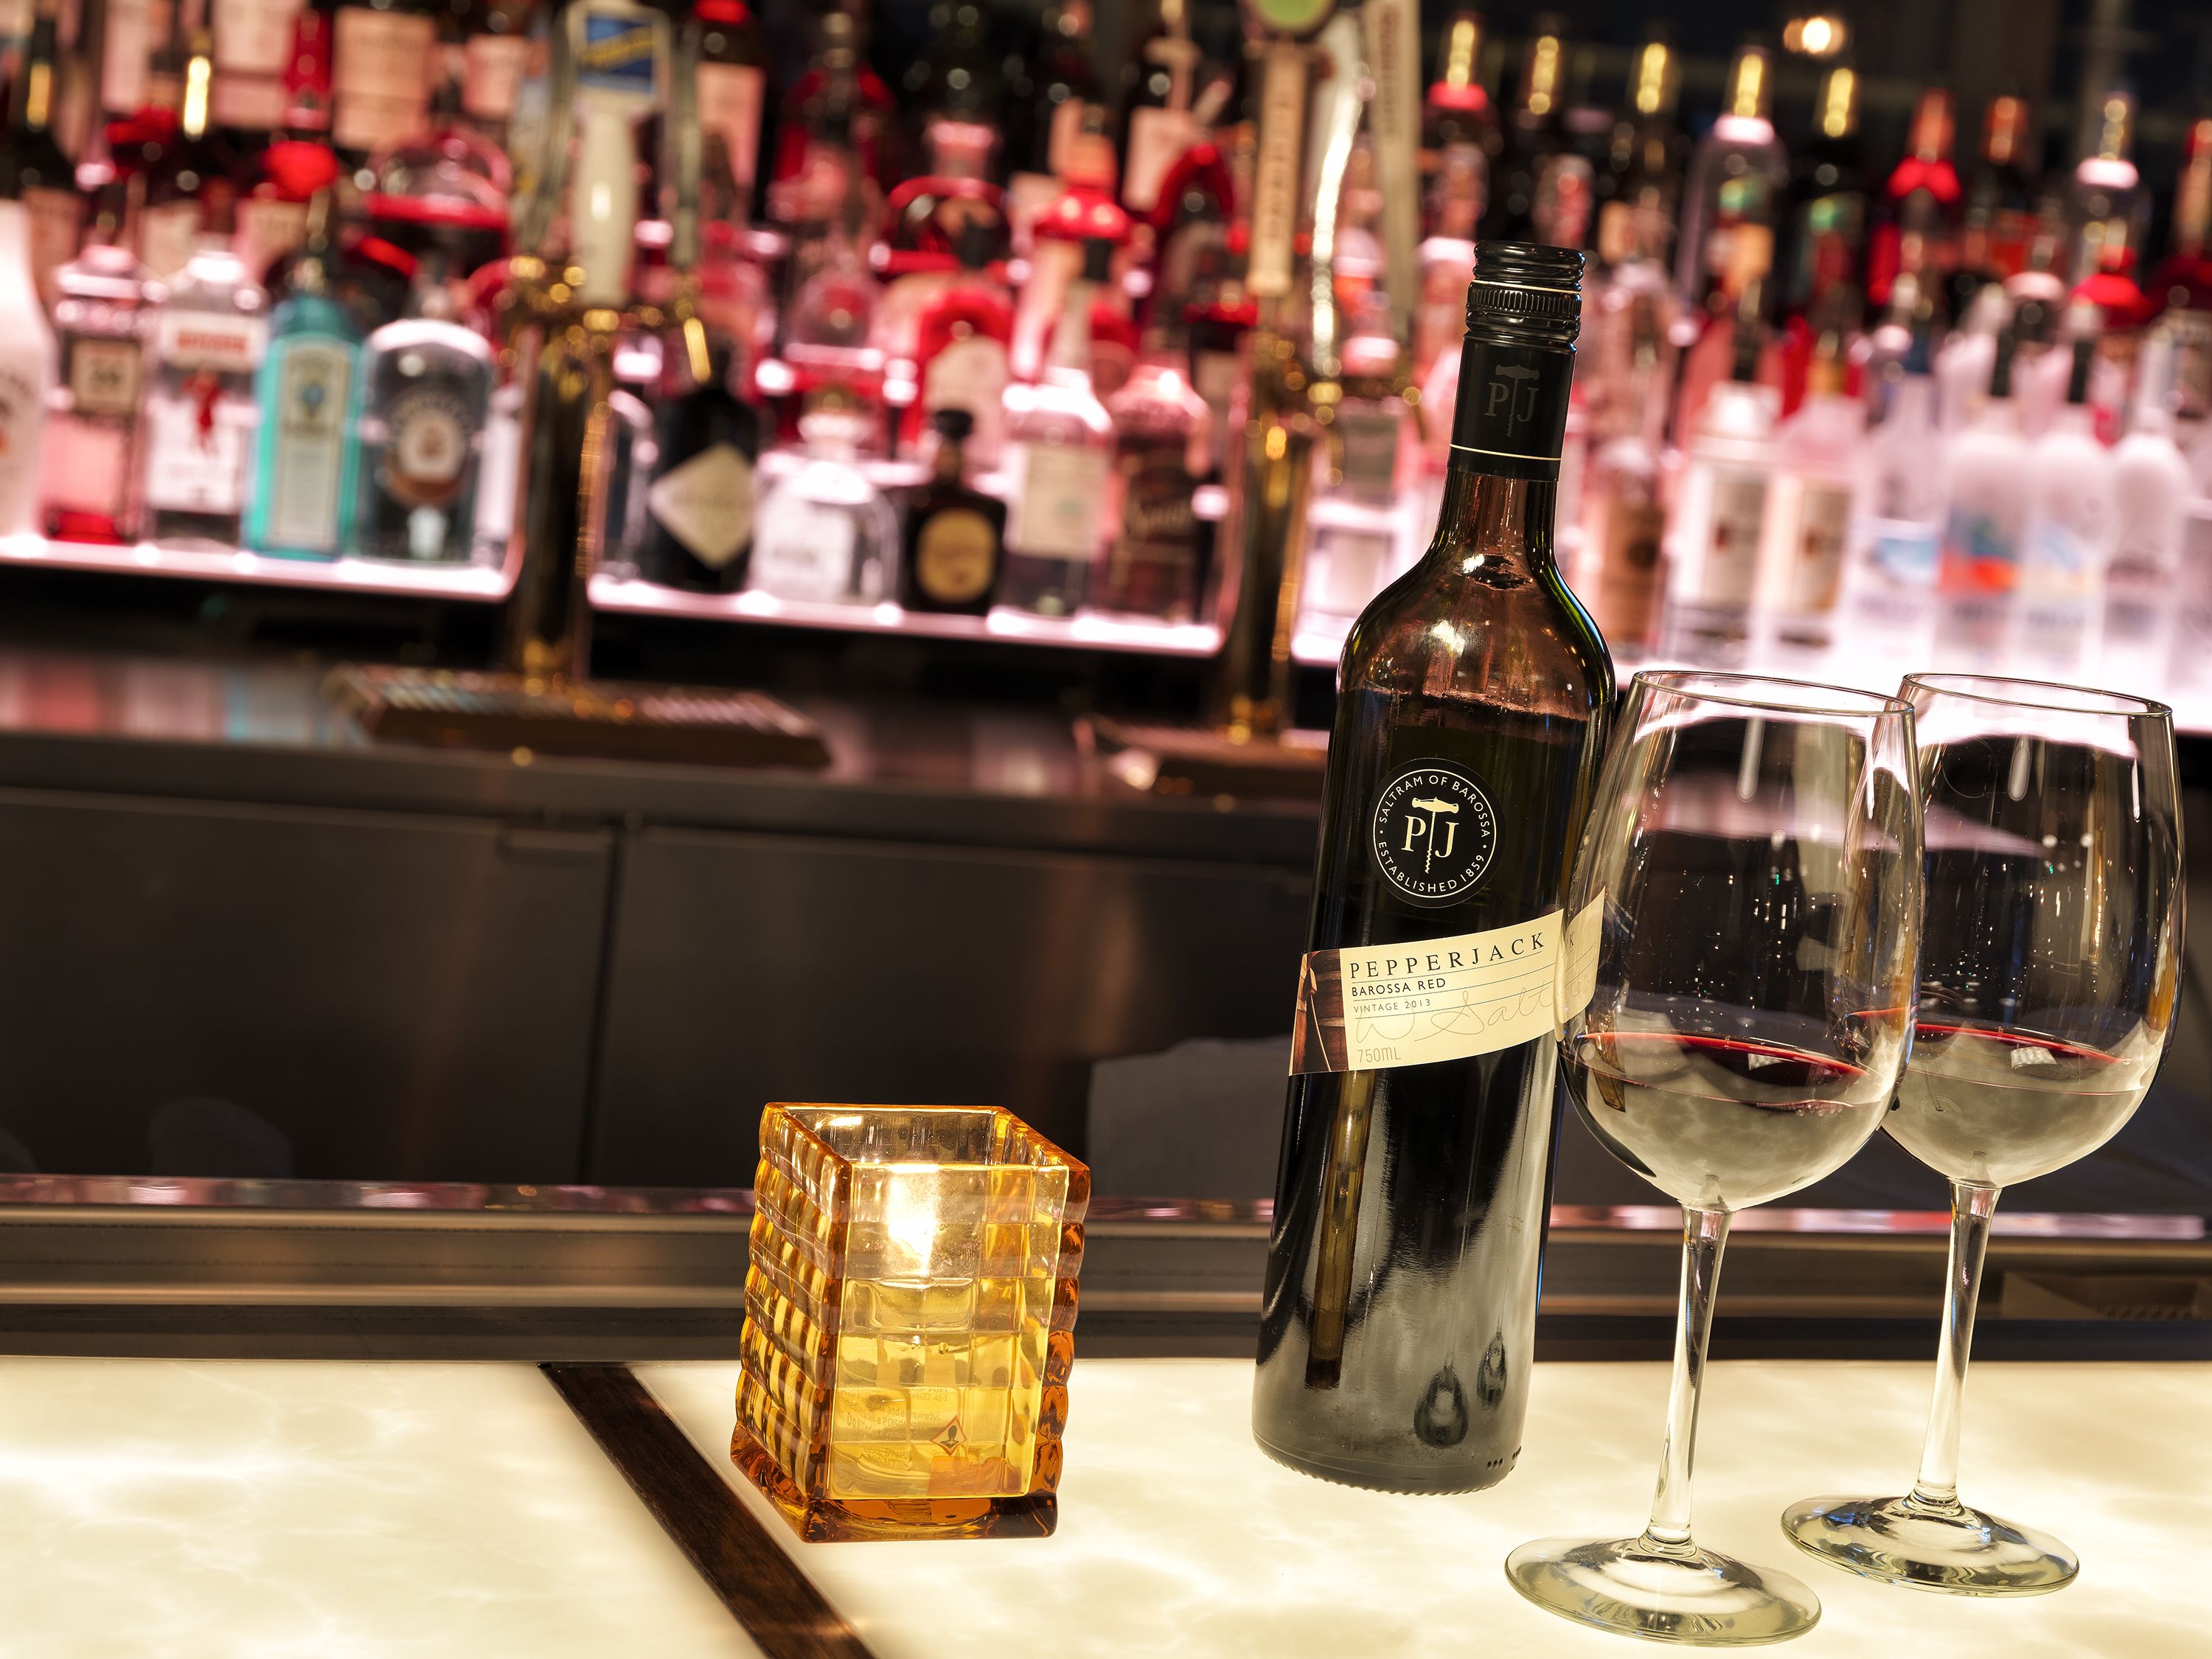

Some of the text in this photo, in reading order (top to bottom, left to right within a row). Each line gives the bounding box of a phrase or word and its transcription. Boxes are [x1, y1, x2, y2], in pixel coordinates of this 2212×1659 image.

[1380, 775, 1491, 838] SALTRAM OF BAROSSA
[1378, 841, 1484, 893] ESTABLISHED 1859
[1349, 932, 1544, 979] PEPPERJACK
[1352, 978, 1446, 997] BAROSSA RED
[1354, 998, 1431, 1013] VINTAGE 2013
